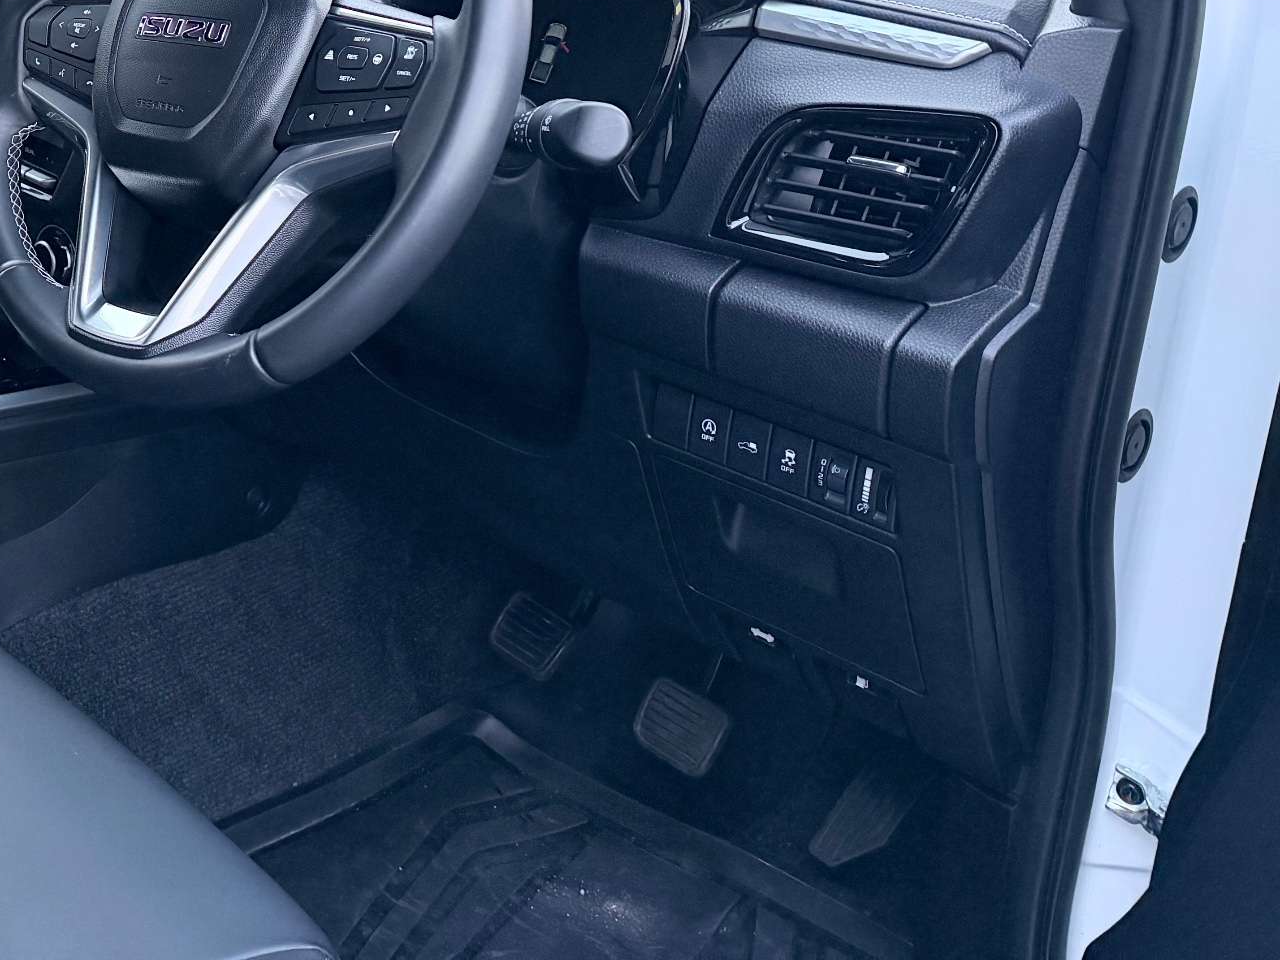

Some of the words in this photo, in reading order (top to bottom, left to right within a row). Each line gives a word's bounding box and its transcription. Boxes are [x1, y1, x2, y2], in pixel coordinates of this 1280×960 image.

[136, 15, 231, 45] ISUZU
[701, 433, 715, 442] OFF
[781, 465, 795, 474] OFF
